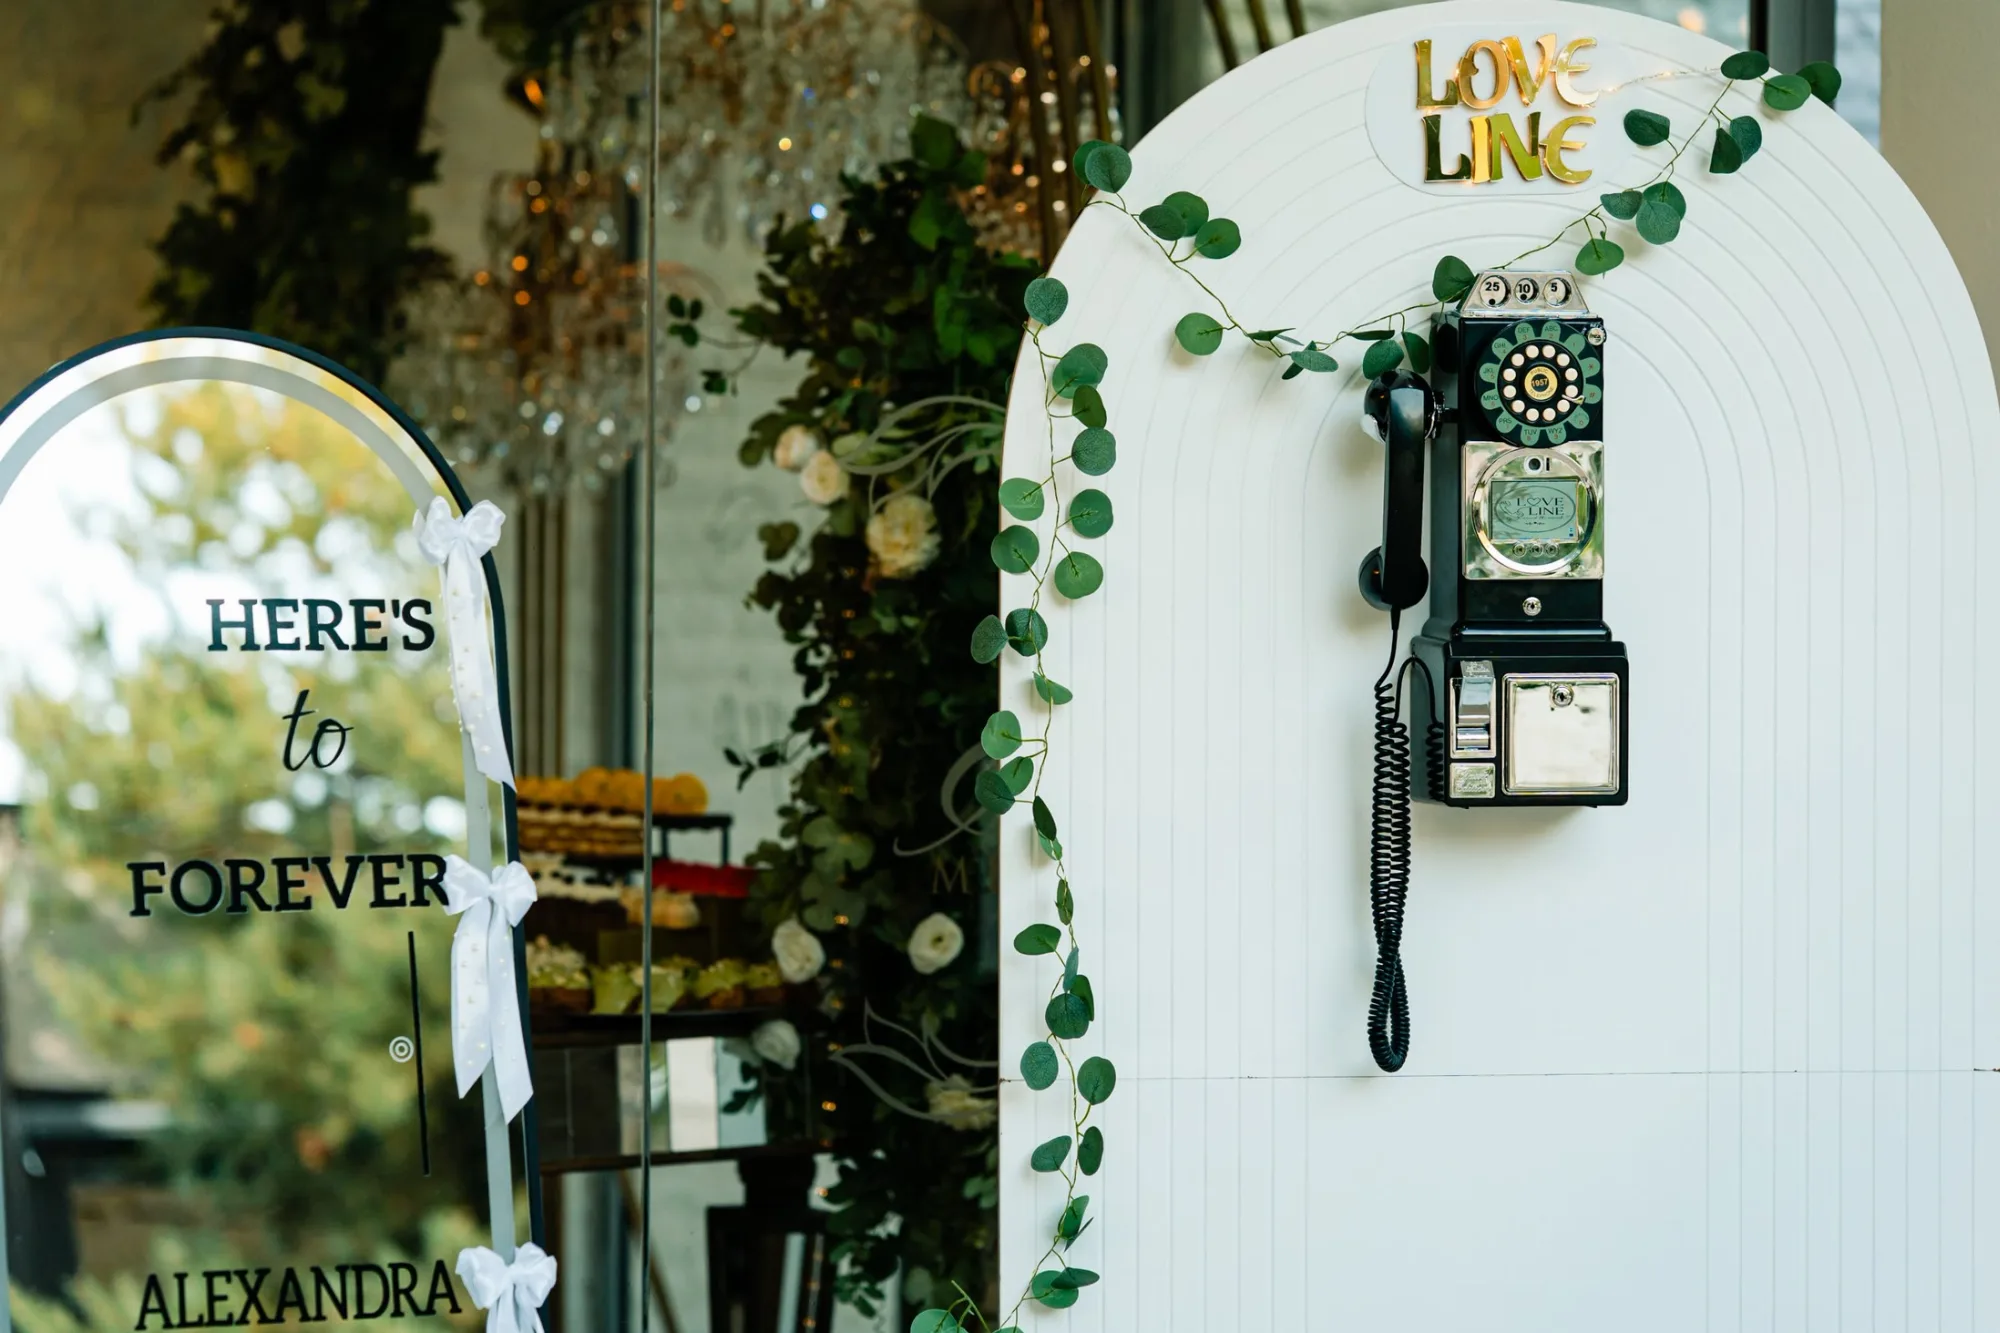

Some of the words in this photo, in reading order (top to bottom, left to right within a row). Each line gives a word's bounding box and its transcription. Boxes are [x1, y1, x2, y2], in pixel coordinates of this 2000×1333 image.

[1414, 33, 1600, 109] LOVE
[1421, 111, 1597, 184] LINE
[1485, 282, 1500, 292] 25
[1518, 284, 1531, 293] 10
[1551, 283, 1558, 292] 5
[1529, 507, 1564, 516] LINE
[206, 597, 435, 652] HERE'S
[281, 689, 354, 771] to
[127, 853, 450, 917] FOREVER
[135, 1260, 462, 1331] ALEXANDRA
